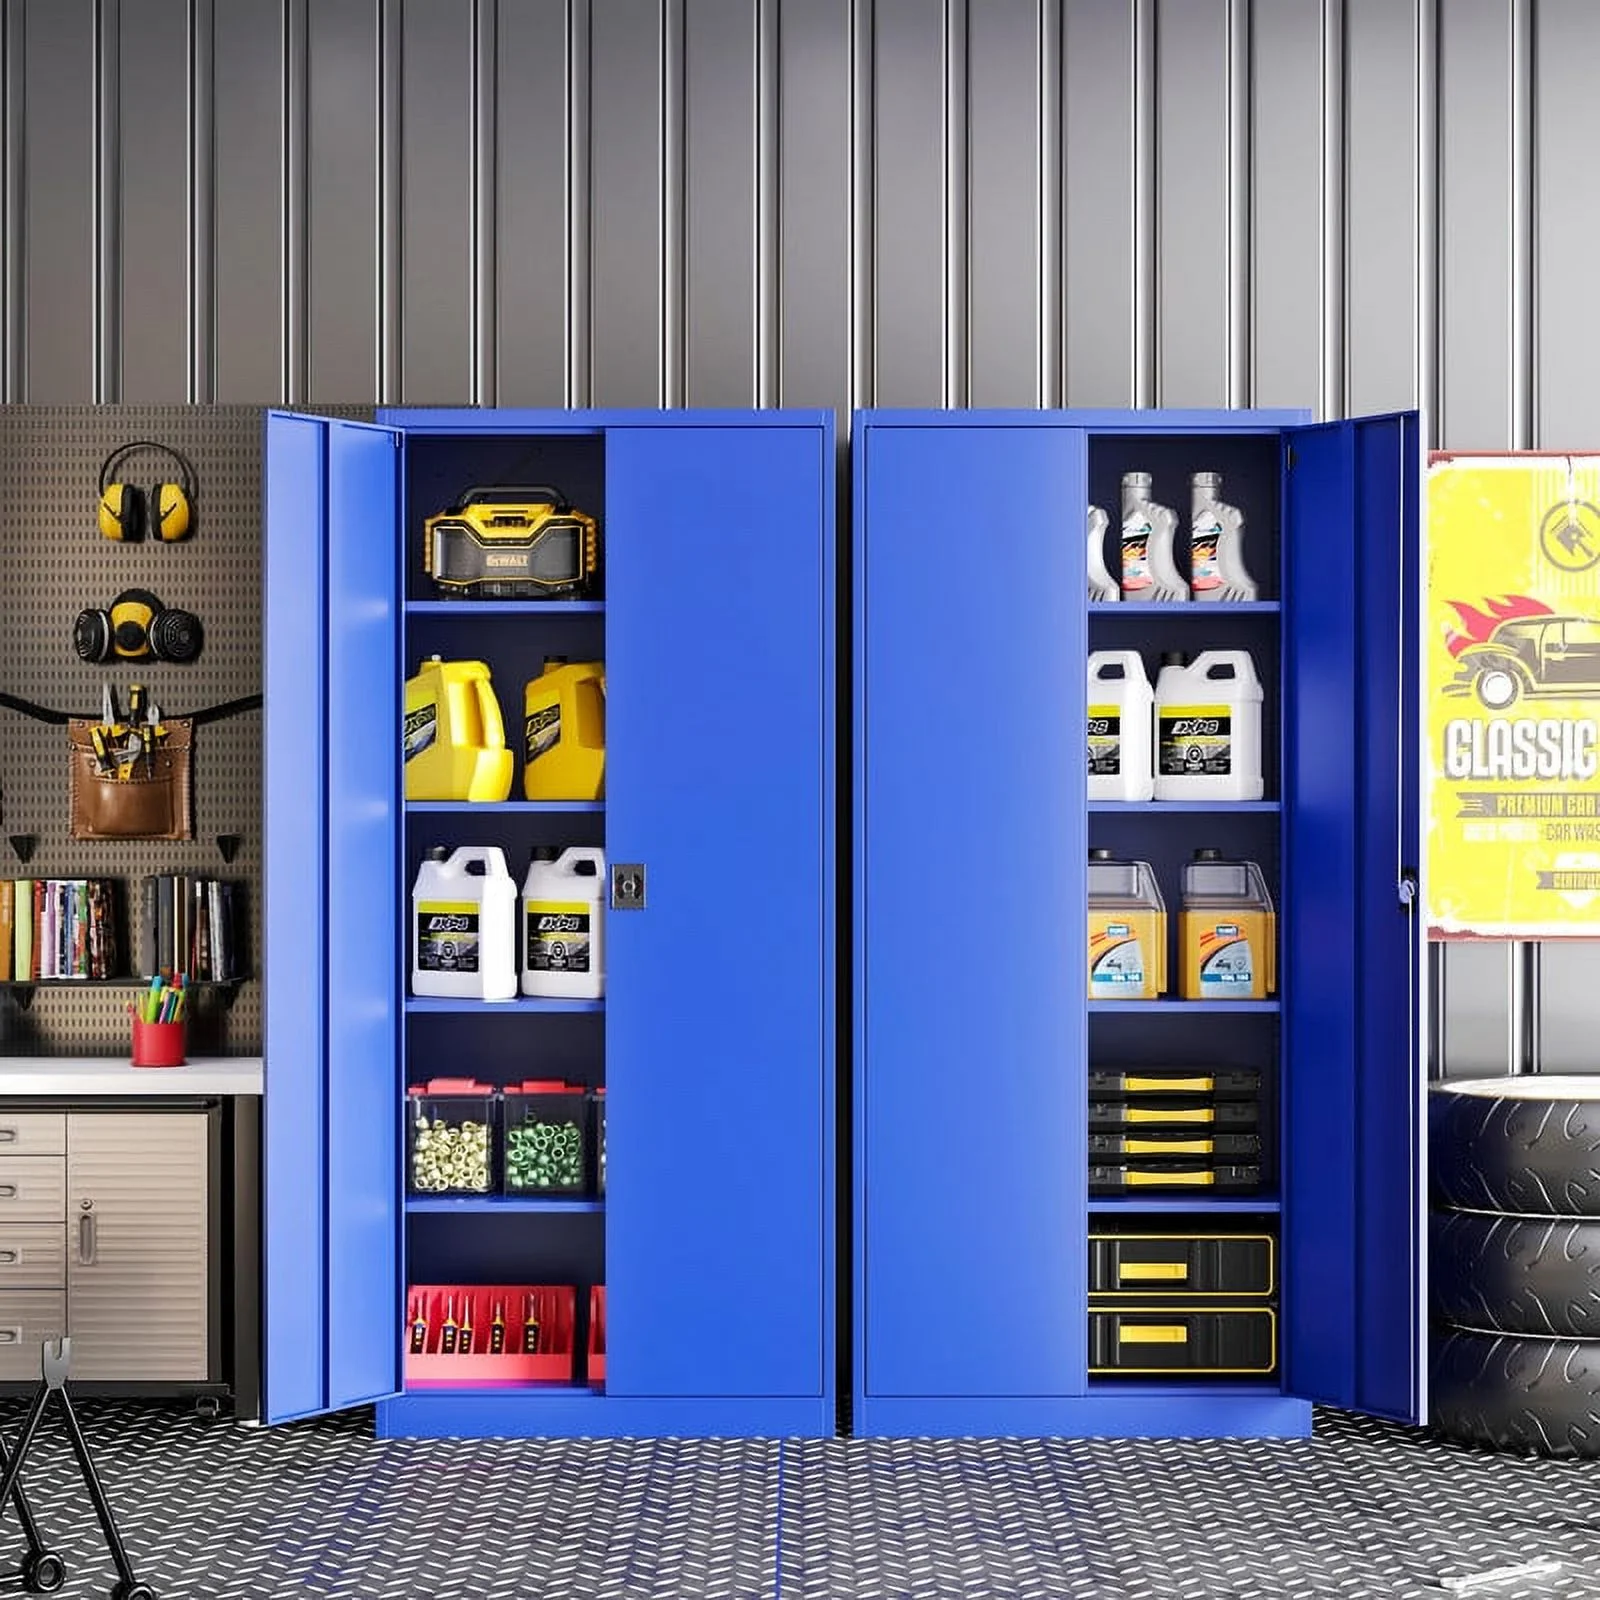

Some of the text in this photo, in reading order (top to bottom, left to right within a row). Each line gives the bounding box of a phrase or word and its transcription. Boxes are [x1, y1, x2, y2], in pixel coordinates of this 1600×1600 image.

[1445, 718, 1598, 780] CLASSIC
[1496, 794, 1564, 817] PREMIUM
[1545, 823, 1571, 841] CAR
